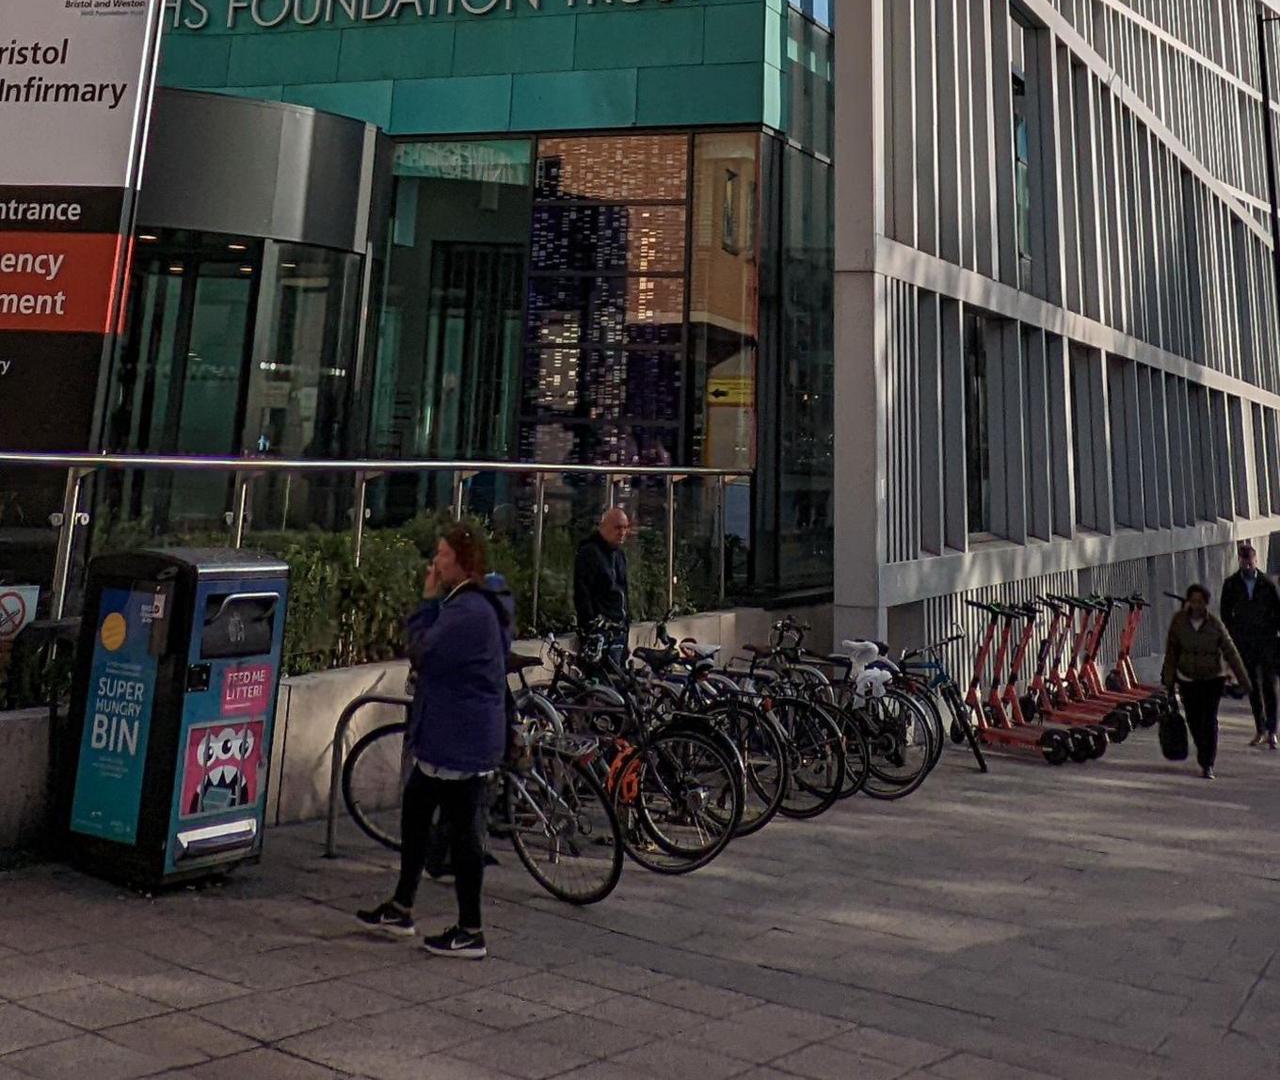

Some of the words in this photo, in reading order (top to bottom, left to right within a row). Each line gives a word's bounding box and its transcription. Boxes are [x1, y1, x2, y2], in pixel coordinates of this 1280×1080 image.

[65, 0, 92, 9] Bristol
[94, 0, 111, 8] and
[113, 0, 146, 9] Weston
[252, 669, 265, 683] ME
[97, 676, 145, 701] SUPER
[226, 684, 263, 700] LITTER!
[95, 699, 142, 718] HUNGRY
[90, 713, 140, 756] BIN
